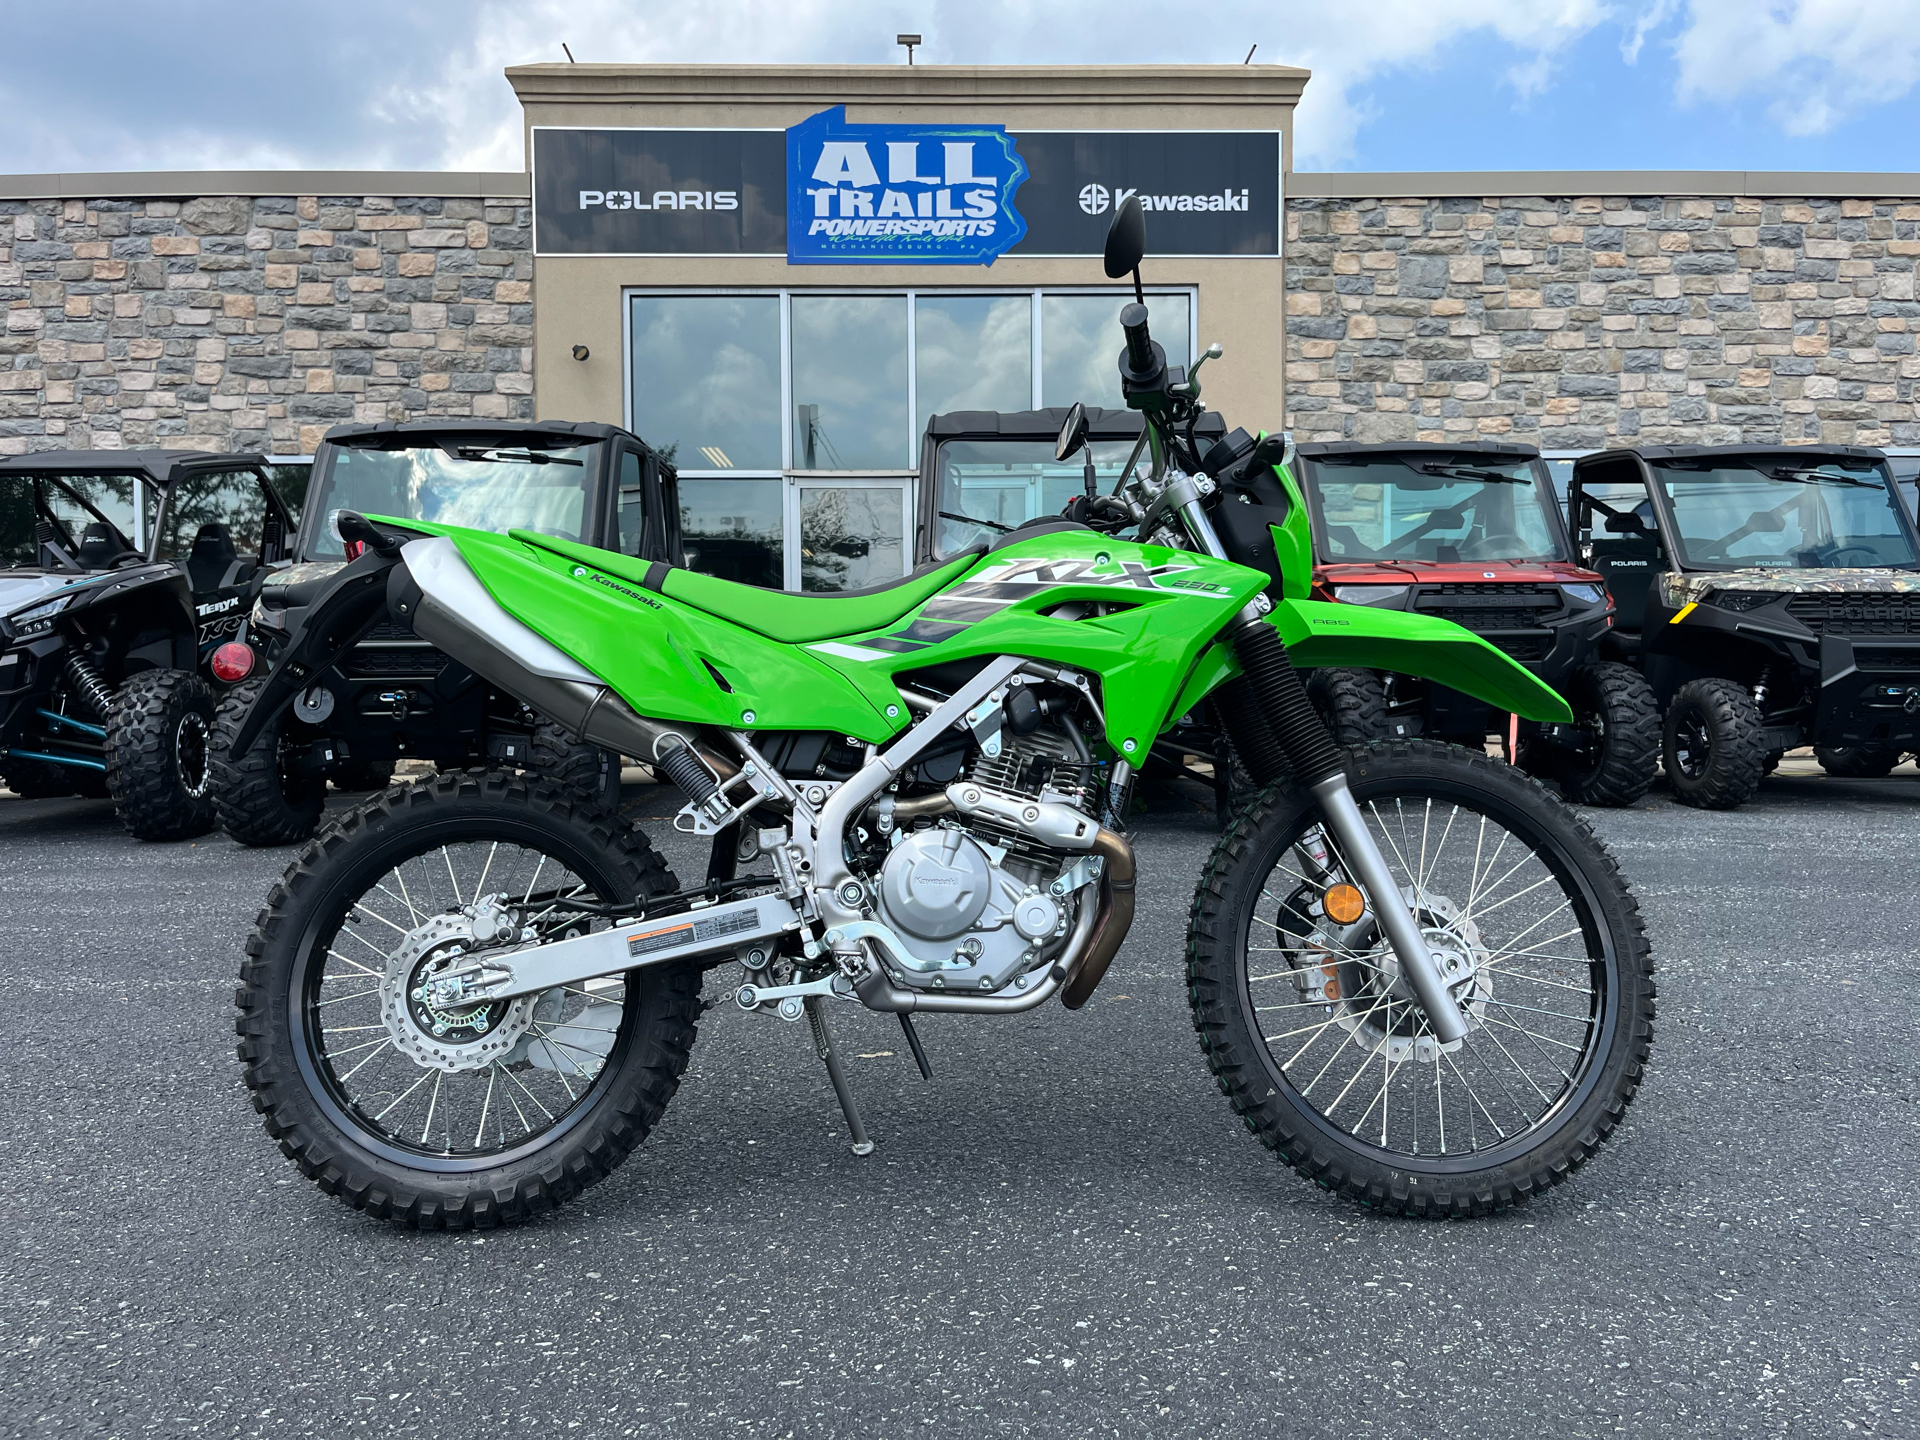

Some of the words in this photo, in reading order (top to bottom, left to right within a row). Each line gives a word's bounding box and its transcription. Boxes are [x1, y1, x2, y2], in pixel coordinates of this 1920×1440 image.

[811, 141, 998, 188] ALL
[579, 190, 739, 210] POLARIS
[806, 188, 998, 218] TRAILS
[1115, 188, 1249, 212] Kawasaki
[808, 219, 997, 237] POWERSPORTS
[985, 558, 1205, 590] KLX
[589, 573, 664, 611] Kawasaki
[1458, 597, 1523, 606] POLARIS
[1312, 618, 1350, 626] ABS
[914, 876, 959, 886] Kawasaki
